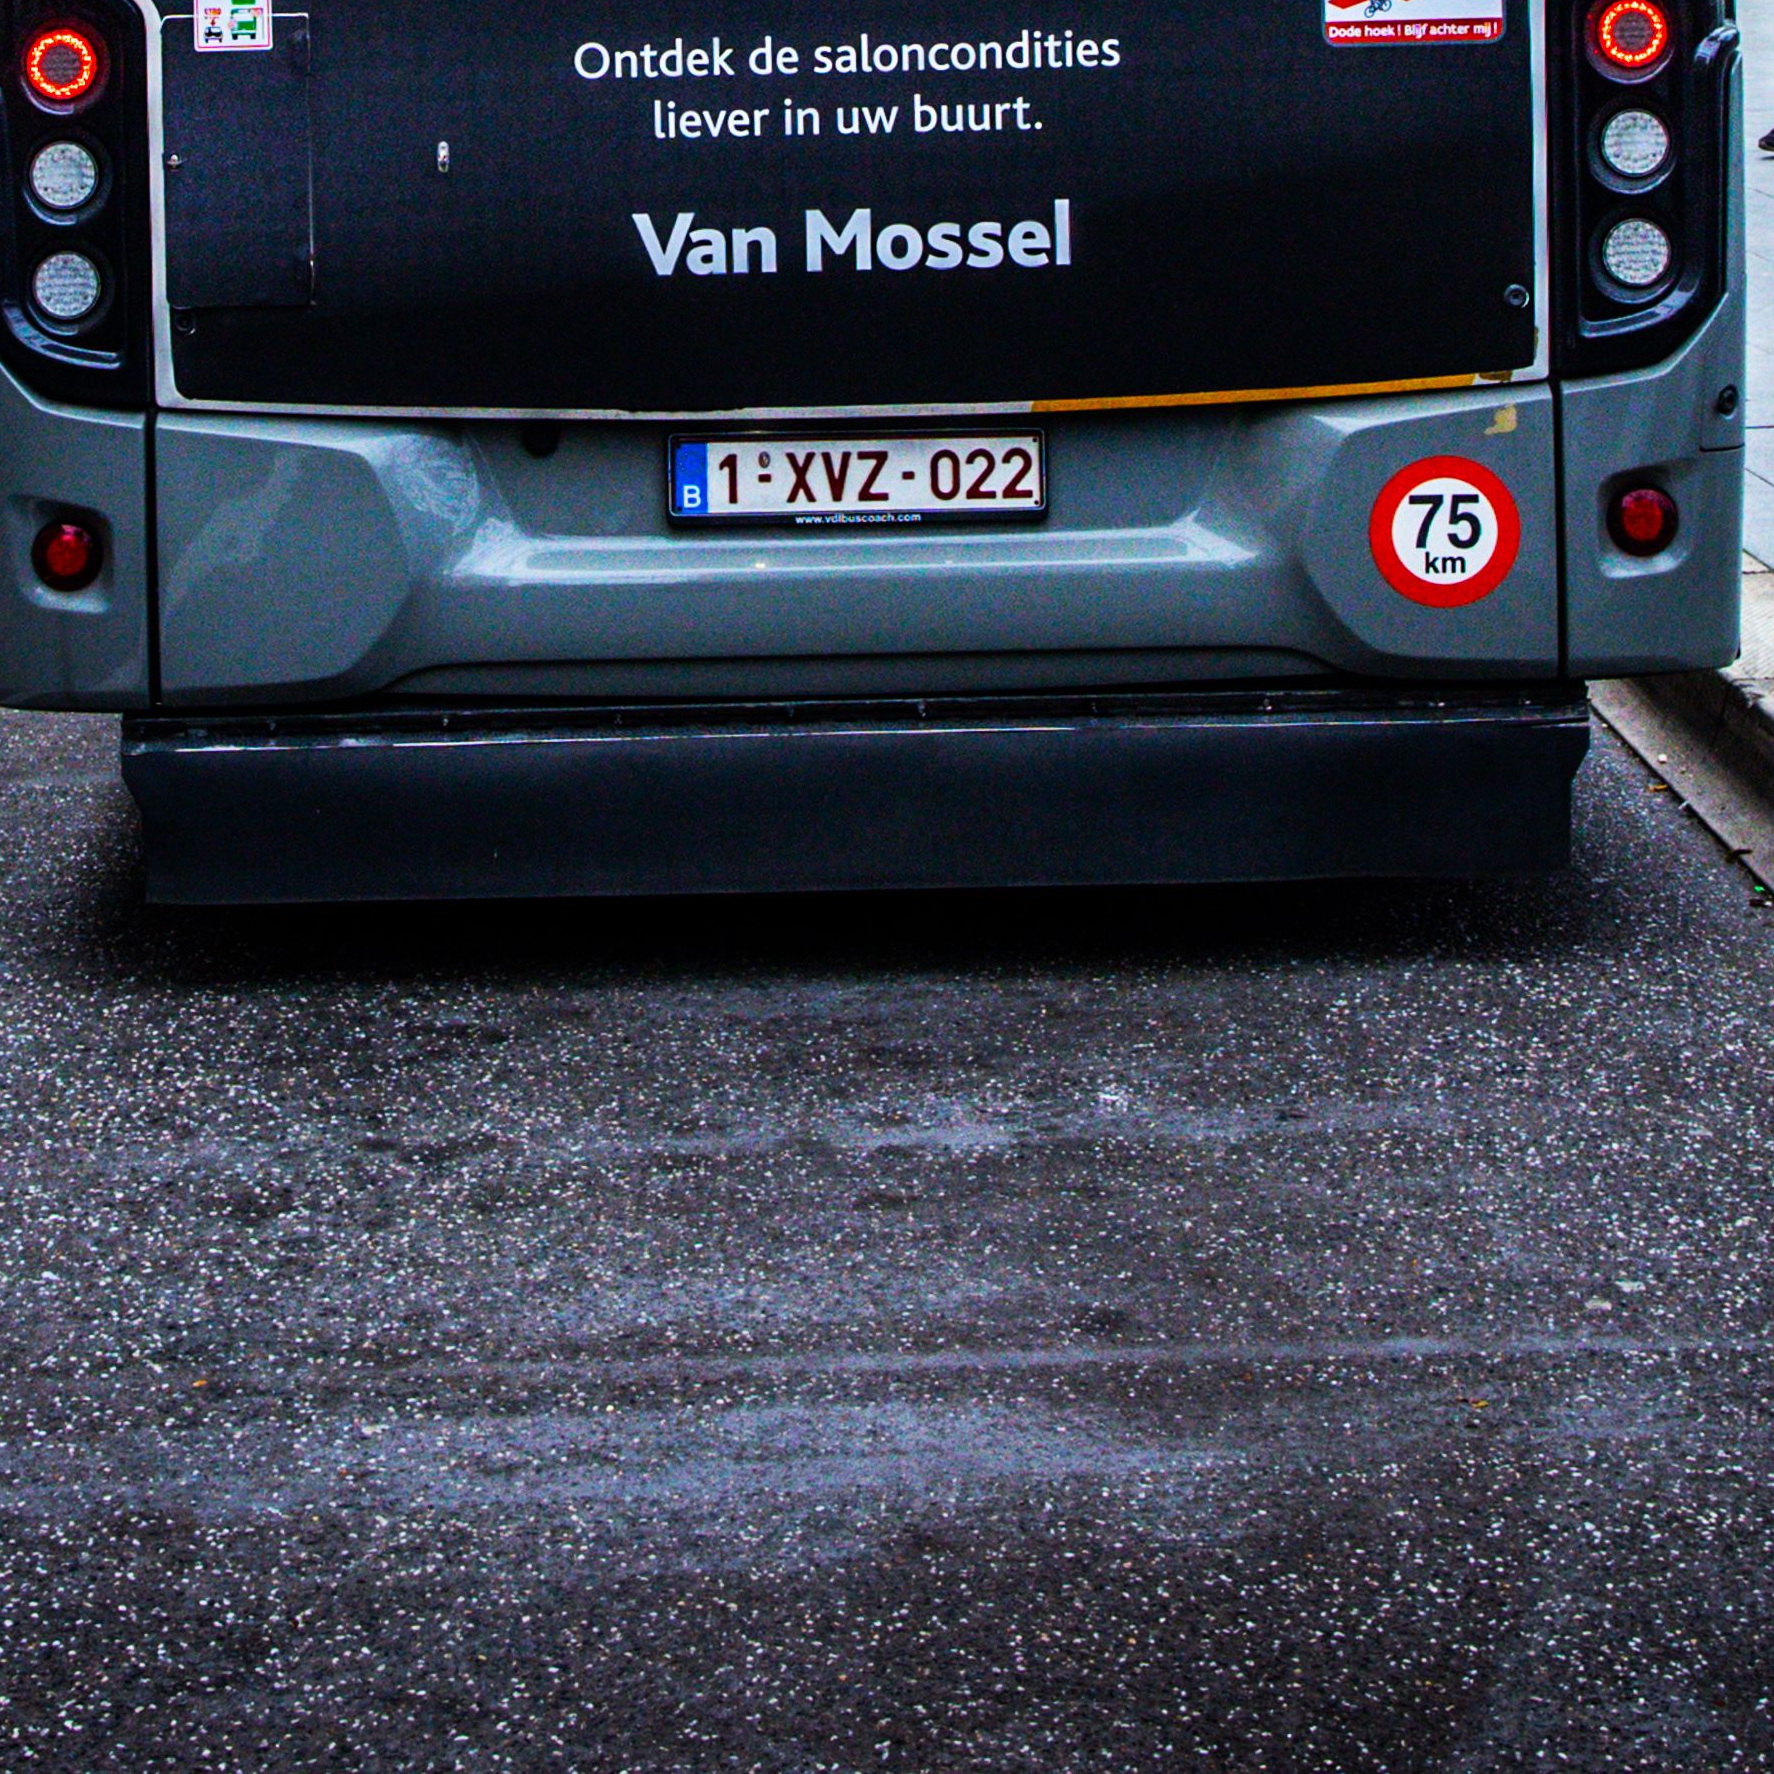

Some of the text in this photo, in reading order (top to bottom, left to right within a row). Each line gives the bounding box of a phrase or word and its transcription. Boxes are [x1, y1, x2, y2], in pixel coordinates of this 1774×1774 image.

[1328, 27, 1362, 38] Dode
[1364, 25, 1396, 37] hoek
[1404, 24, 1429, 39] Blijf
[1429, 24, 1470, 35] achter
[1473, 23, 1492, 37] mij
[574, 29, 1121, 80] Ontdek de saloncondities
[653, 93, 1043, 139] liever in uw buurt.
[631, 198, 1072, 276] Van Mossel
[683, 485, 702, 508] B
[794, 513, 922, 524] www.vdlbuscoach.com
[1408, 494, 1482, 549] 75
[1425, 551, 1466, 574] km
